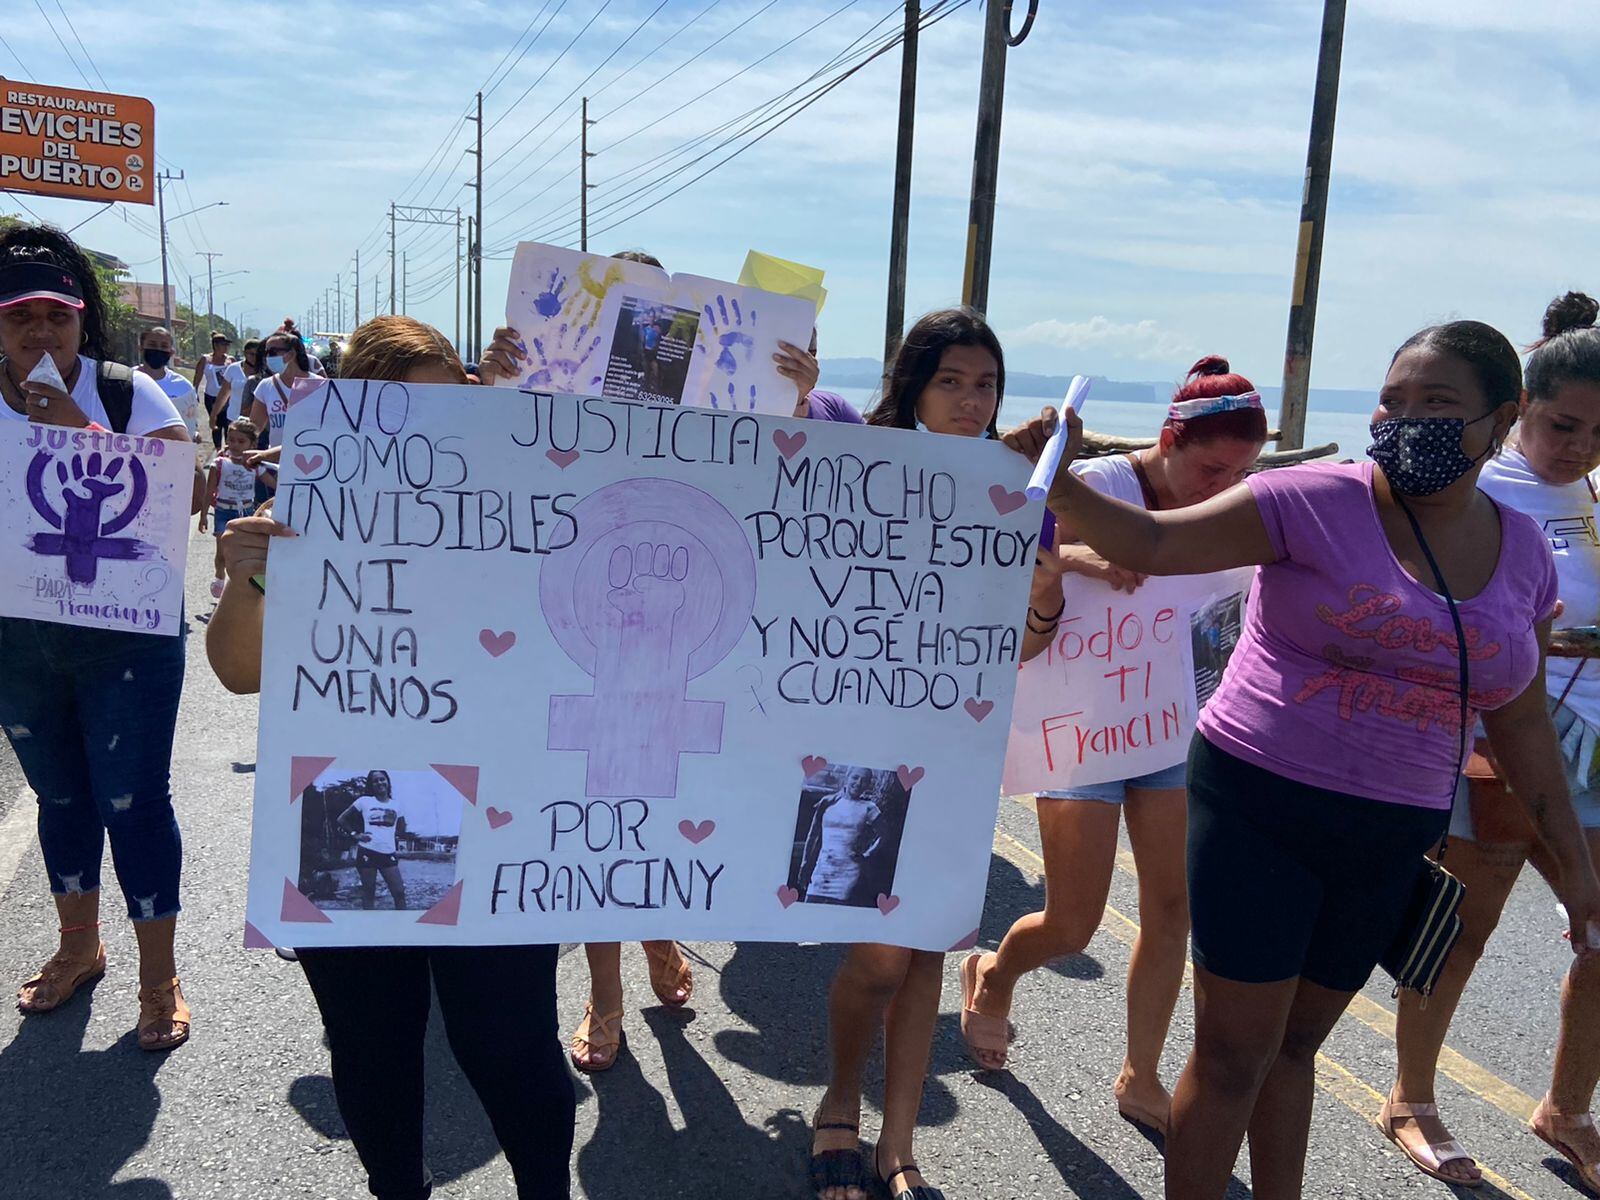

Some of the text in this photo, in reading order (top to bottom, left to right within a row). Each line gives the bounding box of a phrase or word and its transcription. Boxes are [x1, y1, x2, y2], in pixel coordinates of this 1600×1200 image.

[8, 91, 116, 116] RESTAURANTE
[0, 154, 123, 190] PUERTO
[43, 141, 80, 161] DEL
[320, 380, 410, 434] NO
[511, 390, 759, 465] JUSTICIA
[26, 424, 166, 457] JUSTICIA
[294, 429, 467, 489] SOMOS
[772, 454, 957, 522] MARCHO
[279, 482, 578, 555] INVISIBLES
[744, 511, 1038, 567] PORQUE ESTOY
[36, 576, 73, 599] PARA
[318, 558, 412, 615] NI
[809, 565, 944, 613] VIVA
[311, 620, 418, 667] UNA
[751, 615, 779, 657] Y
[917, 621, 1018, 666] HASTA
[293, 665, 458, 724] MENOS
[539, 798, 650, 853] POR
[490, 858, 725, 915] FRANCINY
